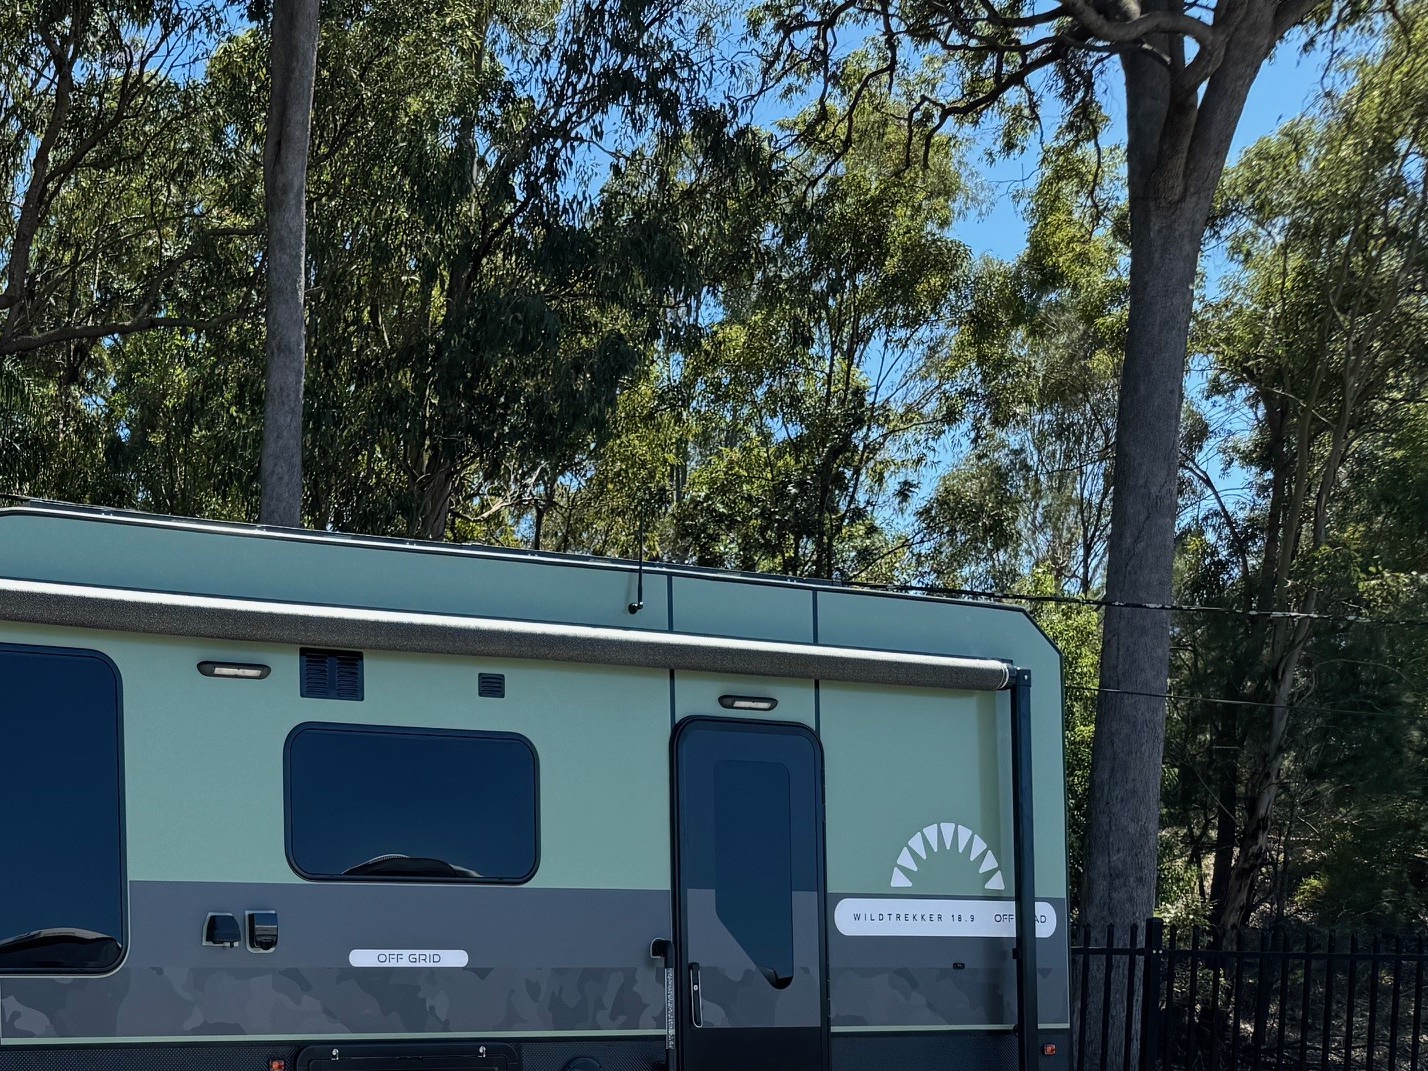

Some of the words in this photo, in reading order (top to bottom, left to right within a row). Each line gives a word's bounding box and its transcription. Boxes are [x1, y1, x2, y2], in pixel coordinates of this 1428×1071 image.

[853, 913, 943, 922] WILDTREKKER
[951, 914, 975, 923] 18.9
[377, 953, 404, 964] OFF
[408, 953, 442, 964] GRID
